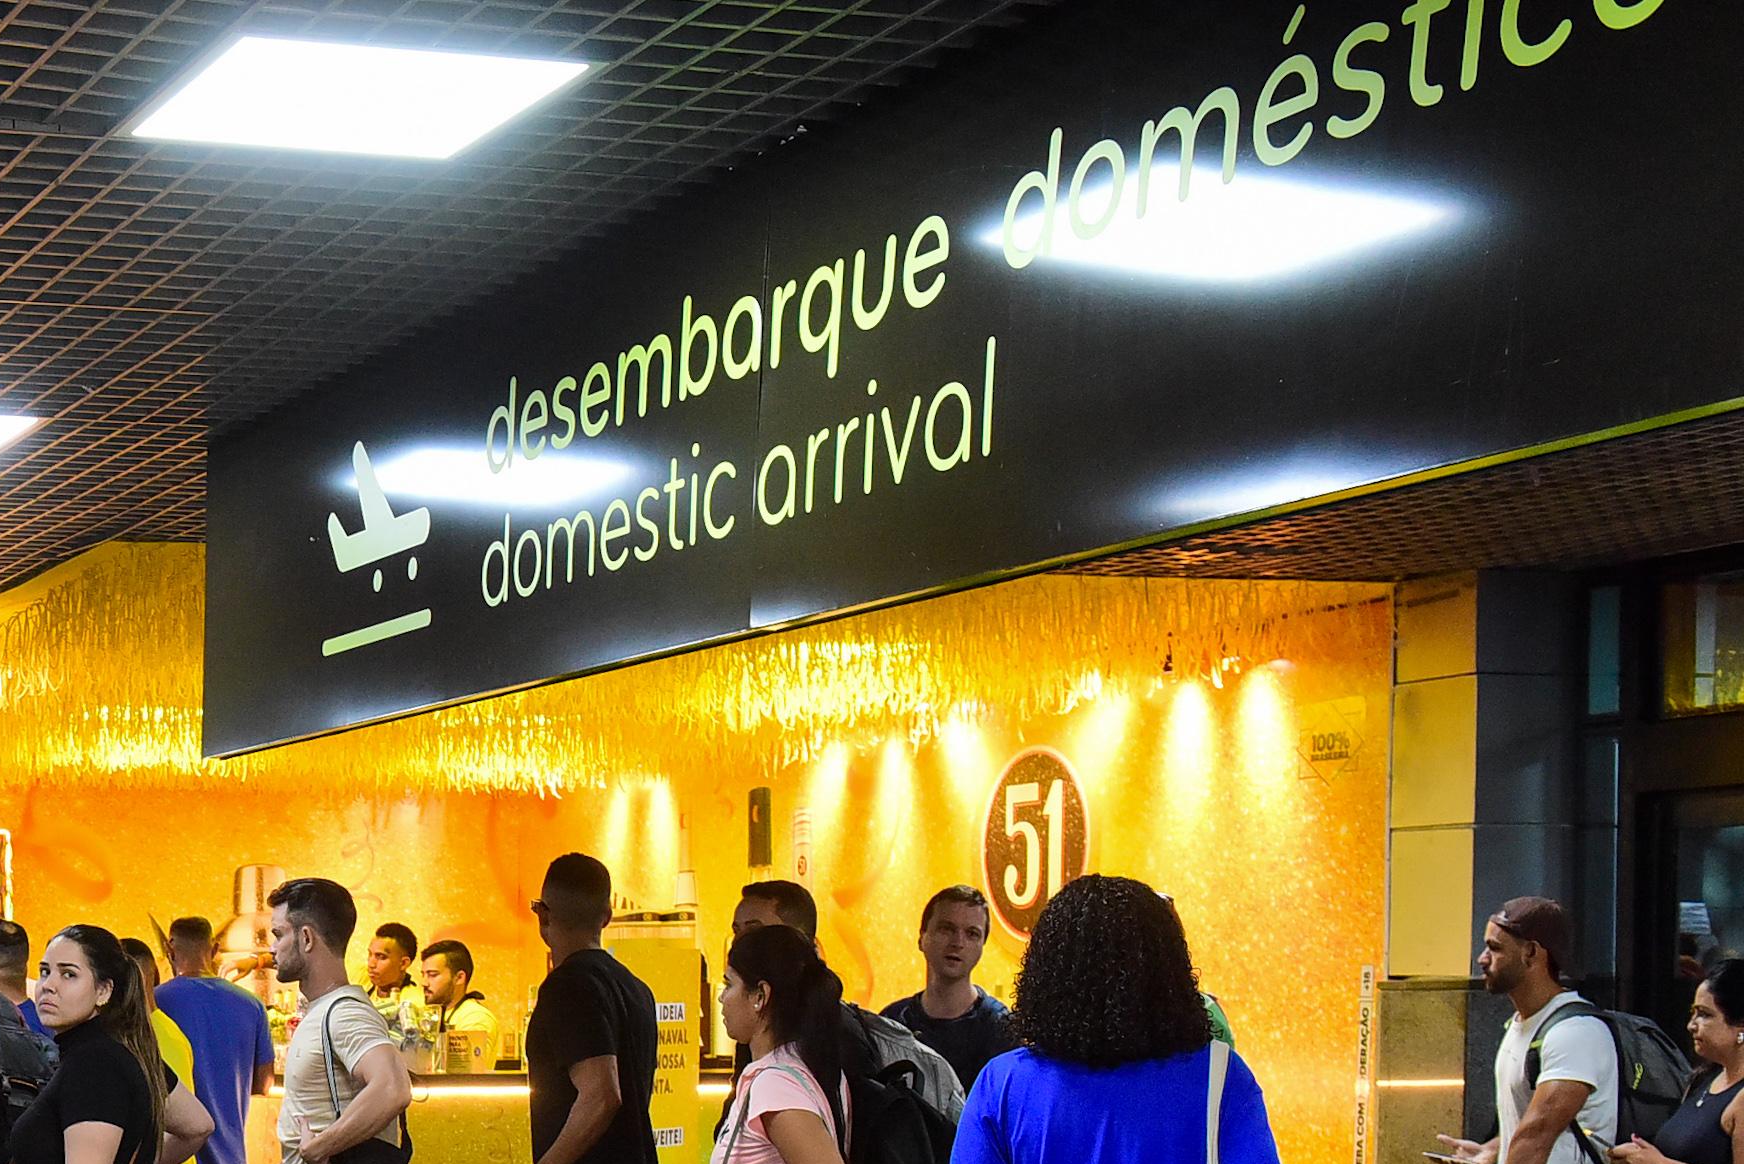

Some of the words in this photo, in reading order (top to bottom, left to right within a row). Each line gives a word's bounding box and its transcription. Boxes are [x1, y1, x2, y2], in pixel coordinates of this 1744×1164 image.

[486, 215, 950, 475] desembarque
[1002, 0, 1660, 269] doméstic
[481, 442, 736, 608] domestic
[758, 336, 997, 526] arrival
[1311, 732, 1350, 752] 100%
[1004, 779, 1064, 905] 51
[659, 1005, 684, 1021] IDEIA
[658, 1027, 689, 1045] NAVAL
[1356, 1102, 1366, 1136] COM
